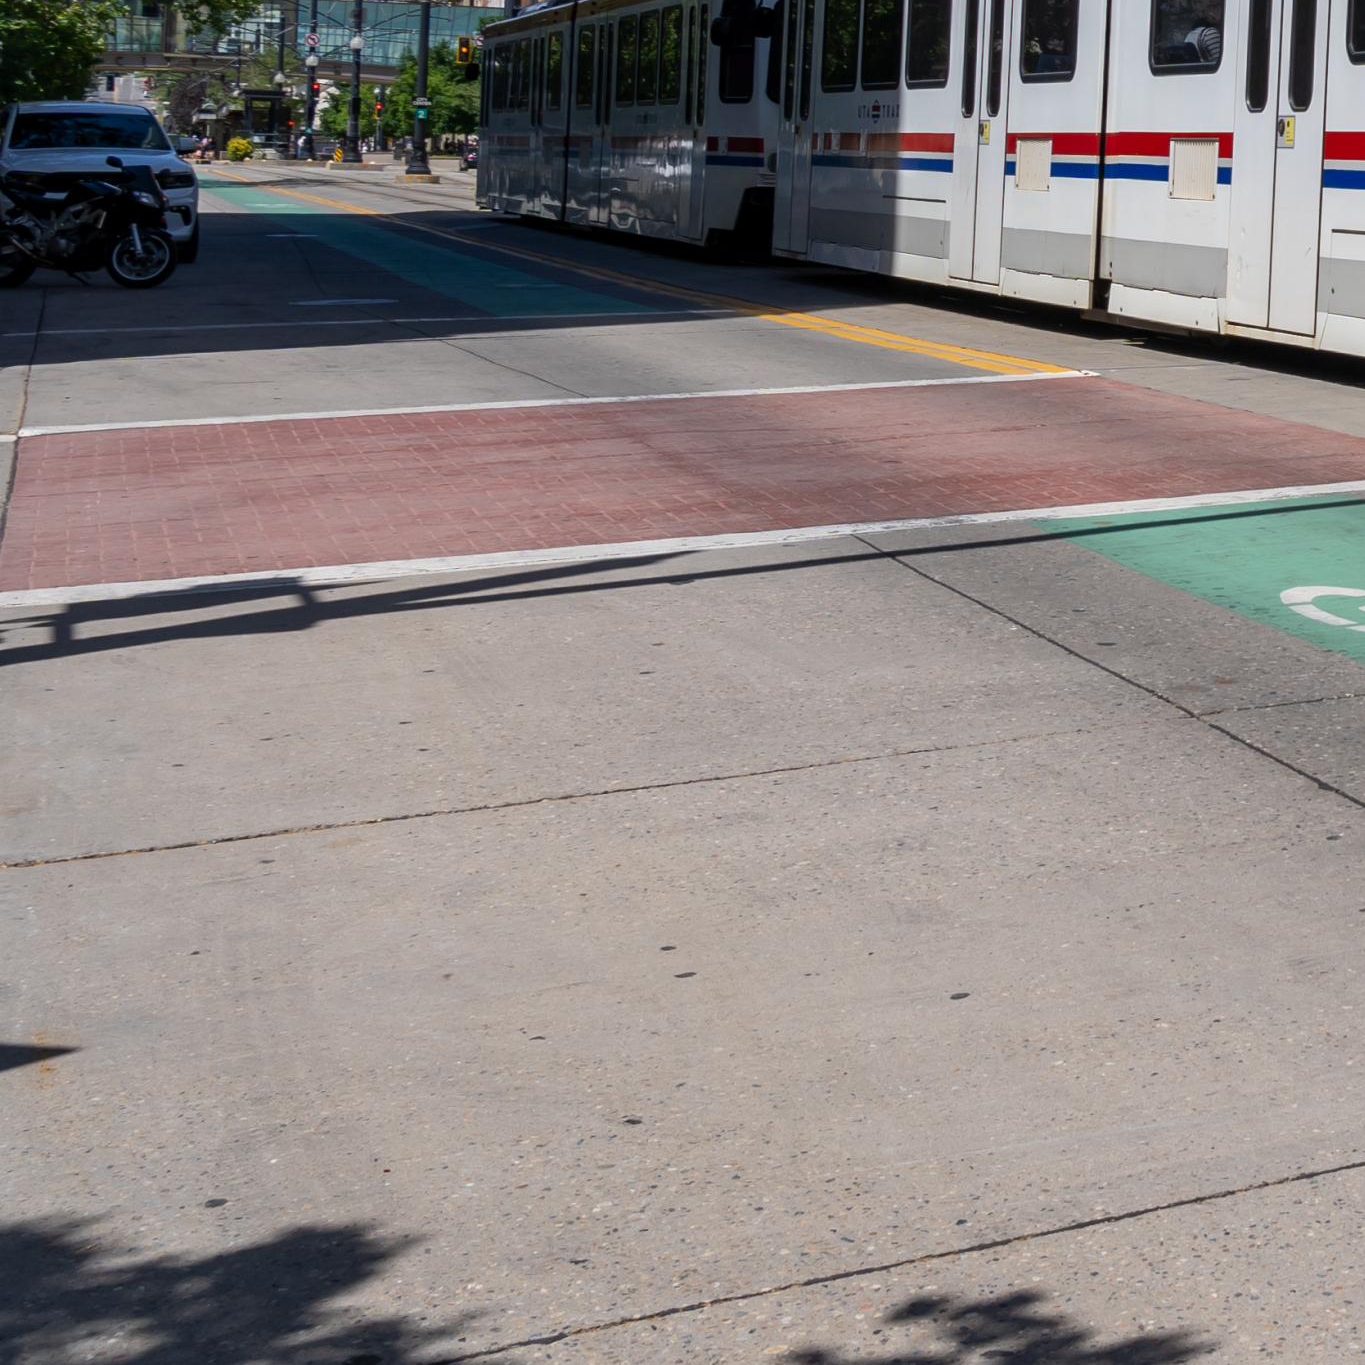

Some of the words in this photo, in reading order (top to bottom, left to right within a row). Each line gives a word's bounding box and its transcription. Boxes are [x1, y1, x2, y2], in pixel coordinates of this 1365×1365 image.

[417, 110, 425, 119] 2
[857, 105, 870, 119] UTA
[882, 104, 900, 119] TRAX
